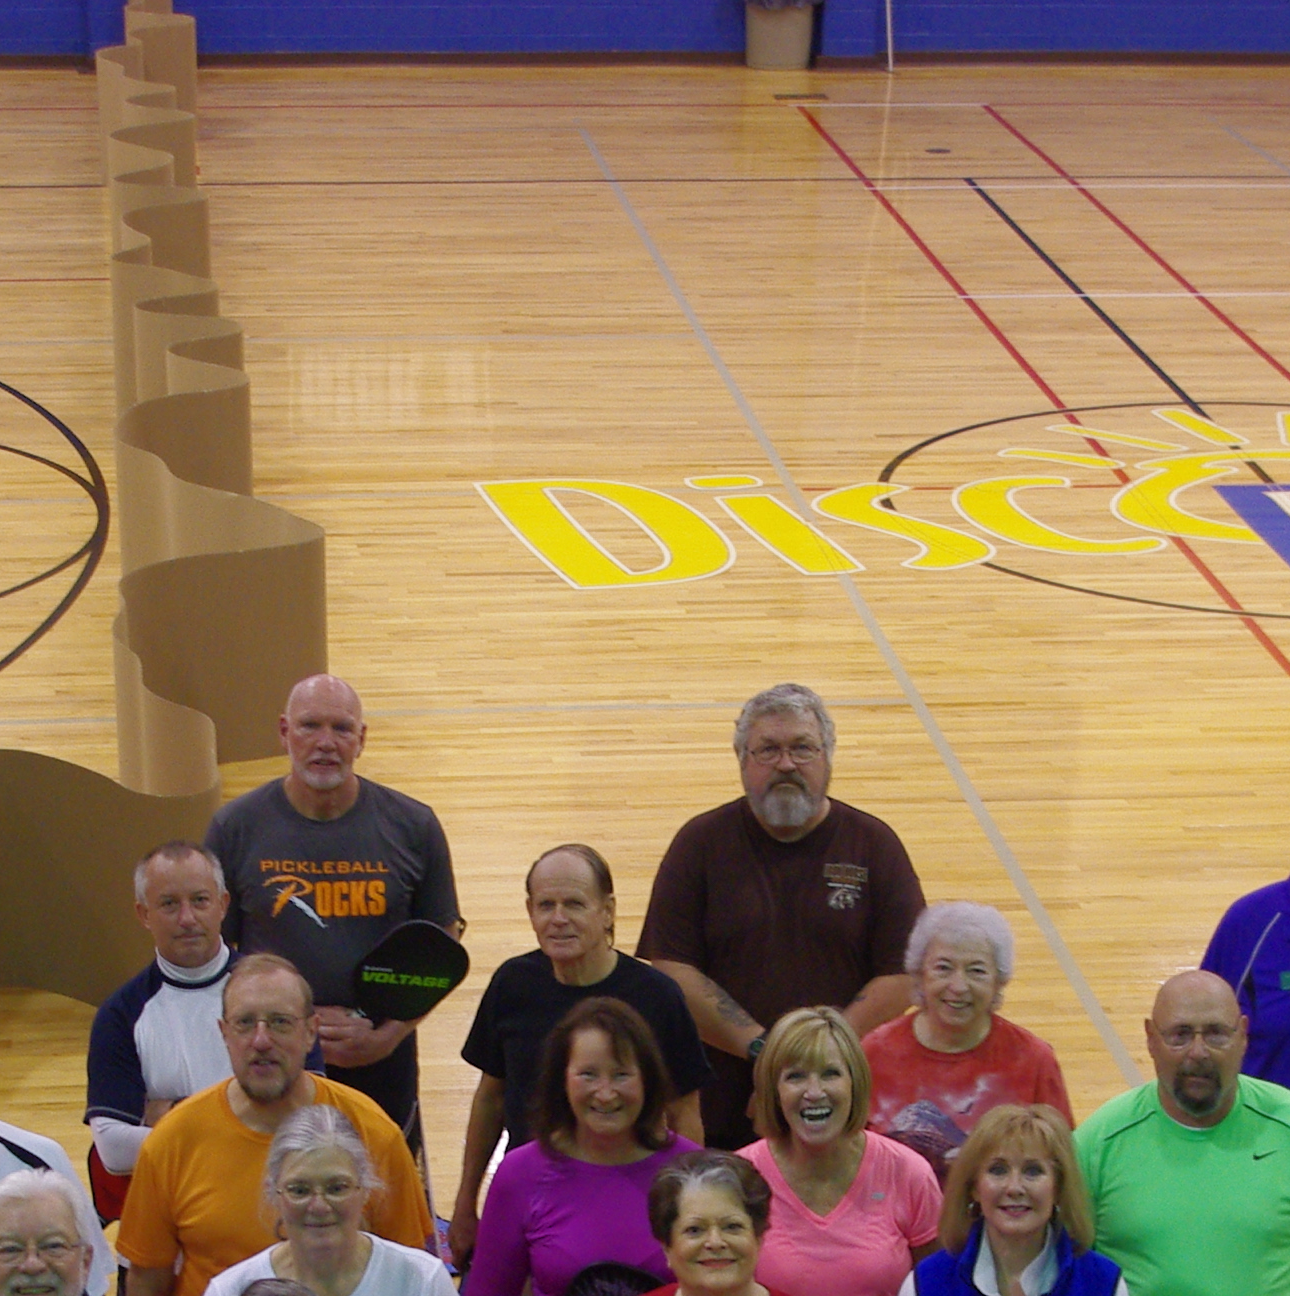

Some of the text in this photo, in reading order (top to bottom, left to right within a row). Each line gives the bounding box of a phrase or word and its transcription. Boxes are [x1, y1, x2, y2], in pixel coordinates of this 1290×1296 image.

[260, 859, 390, 875] PICKLEBALL
[262, 874, 388, 929] ROCKS
[361, 970, 451, 989] VOLTAGE
